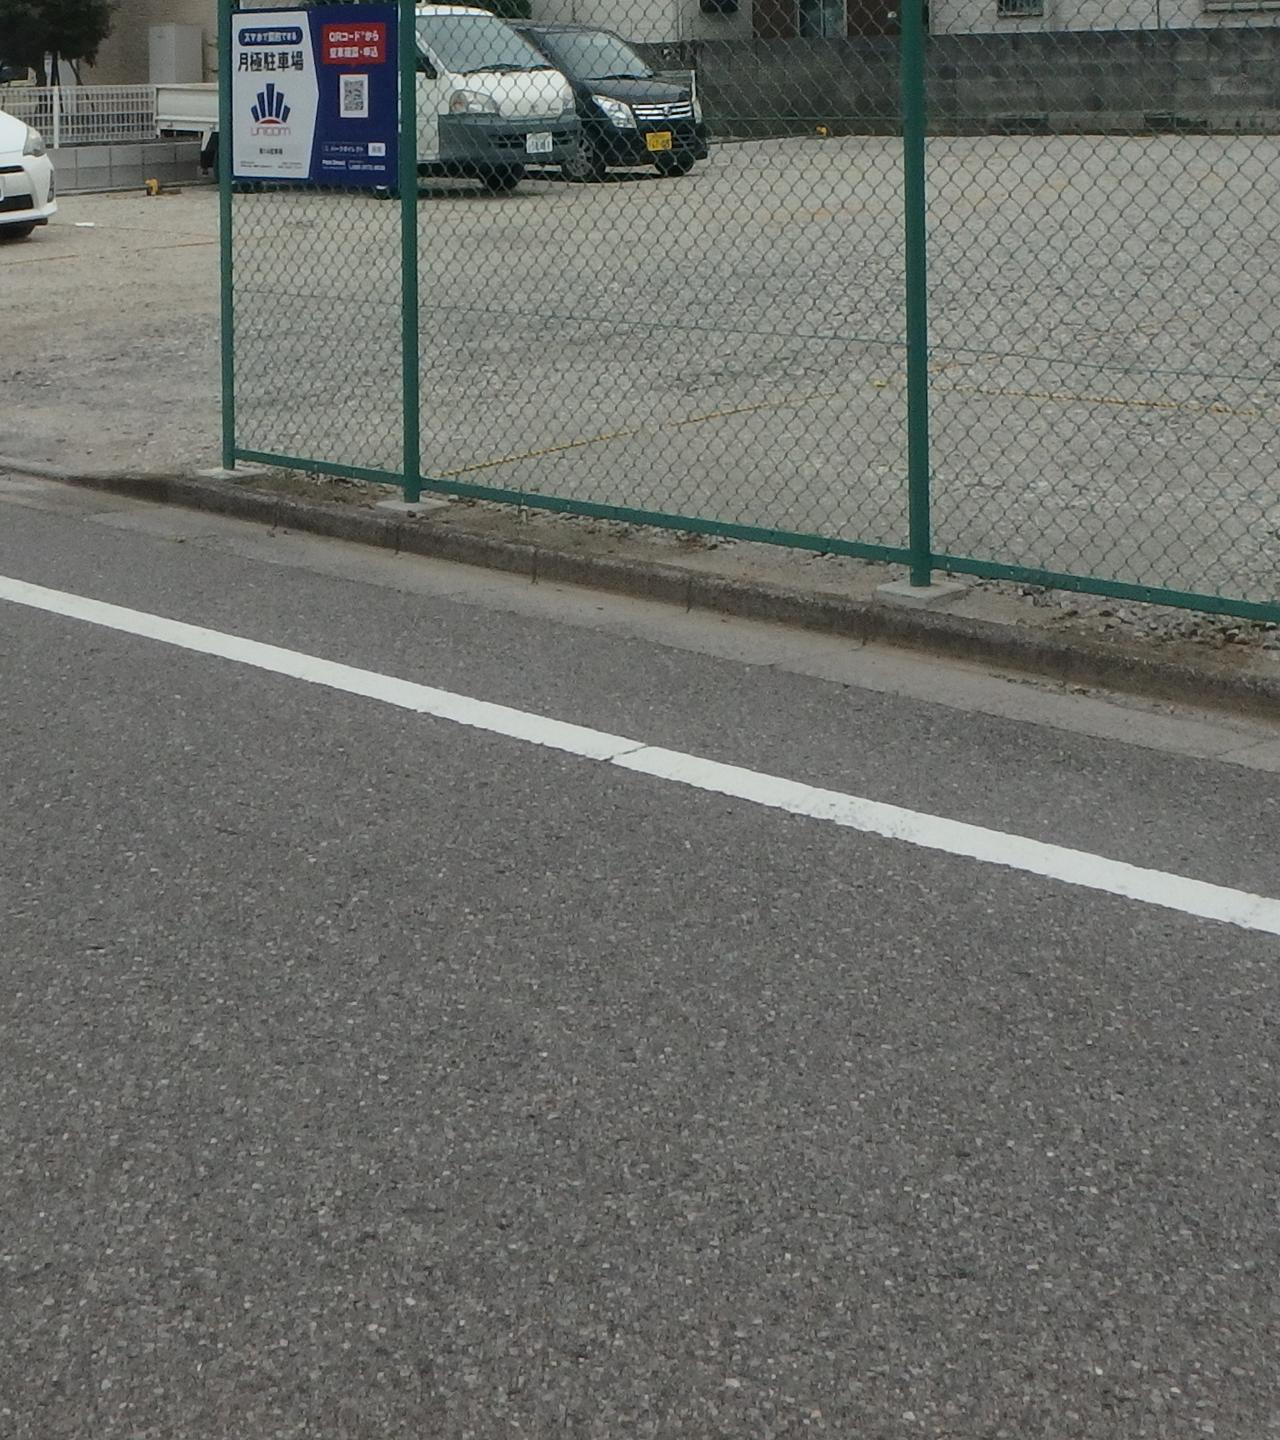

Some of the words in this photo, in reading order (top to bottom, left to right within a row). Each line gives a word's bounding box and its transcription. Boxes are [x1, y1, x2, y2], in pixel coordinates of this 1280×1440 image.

[238, 51, 304, 72] 月極駐車場
